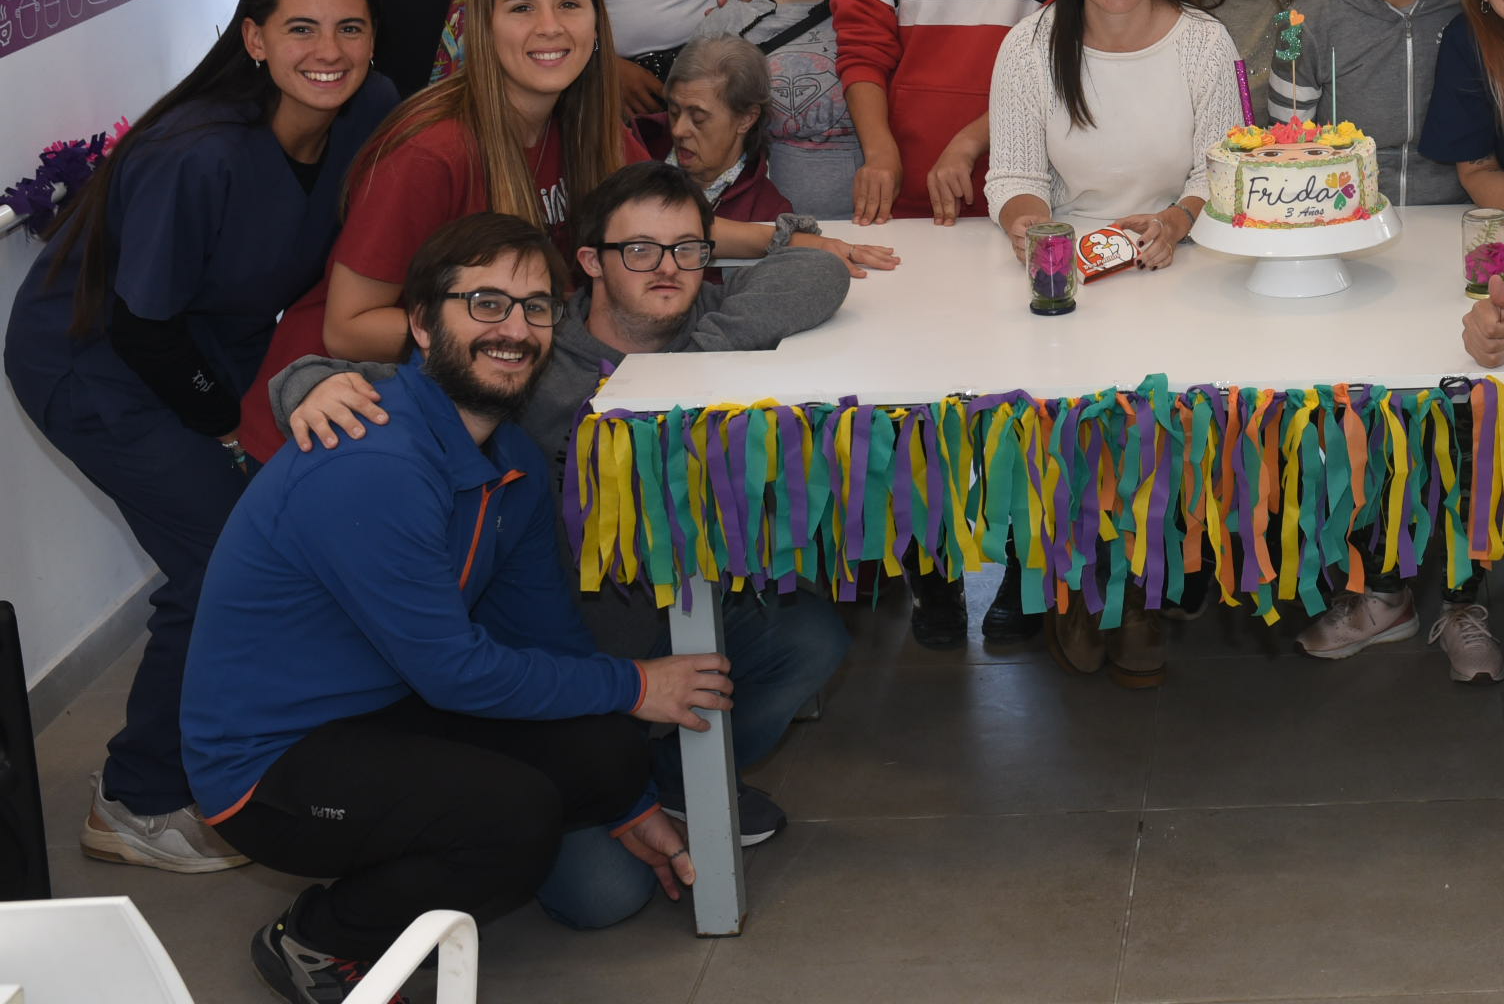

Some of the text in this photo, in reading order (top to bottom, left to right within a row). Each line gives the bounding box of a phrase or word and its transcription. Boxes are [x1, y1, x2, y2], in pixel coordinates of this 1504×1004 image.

[1272, 9, 1303, 61] 3
[1246, 175, 1339, 210] Frida
[1284, 206, 1325, 218] 3 Años
